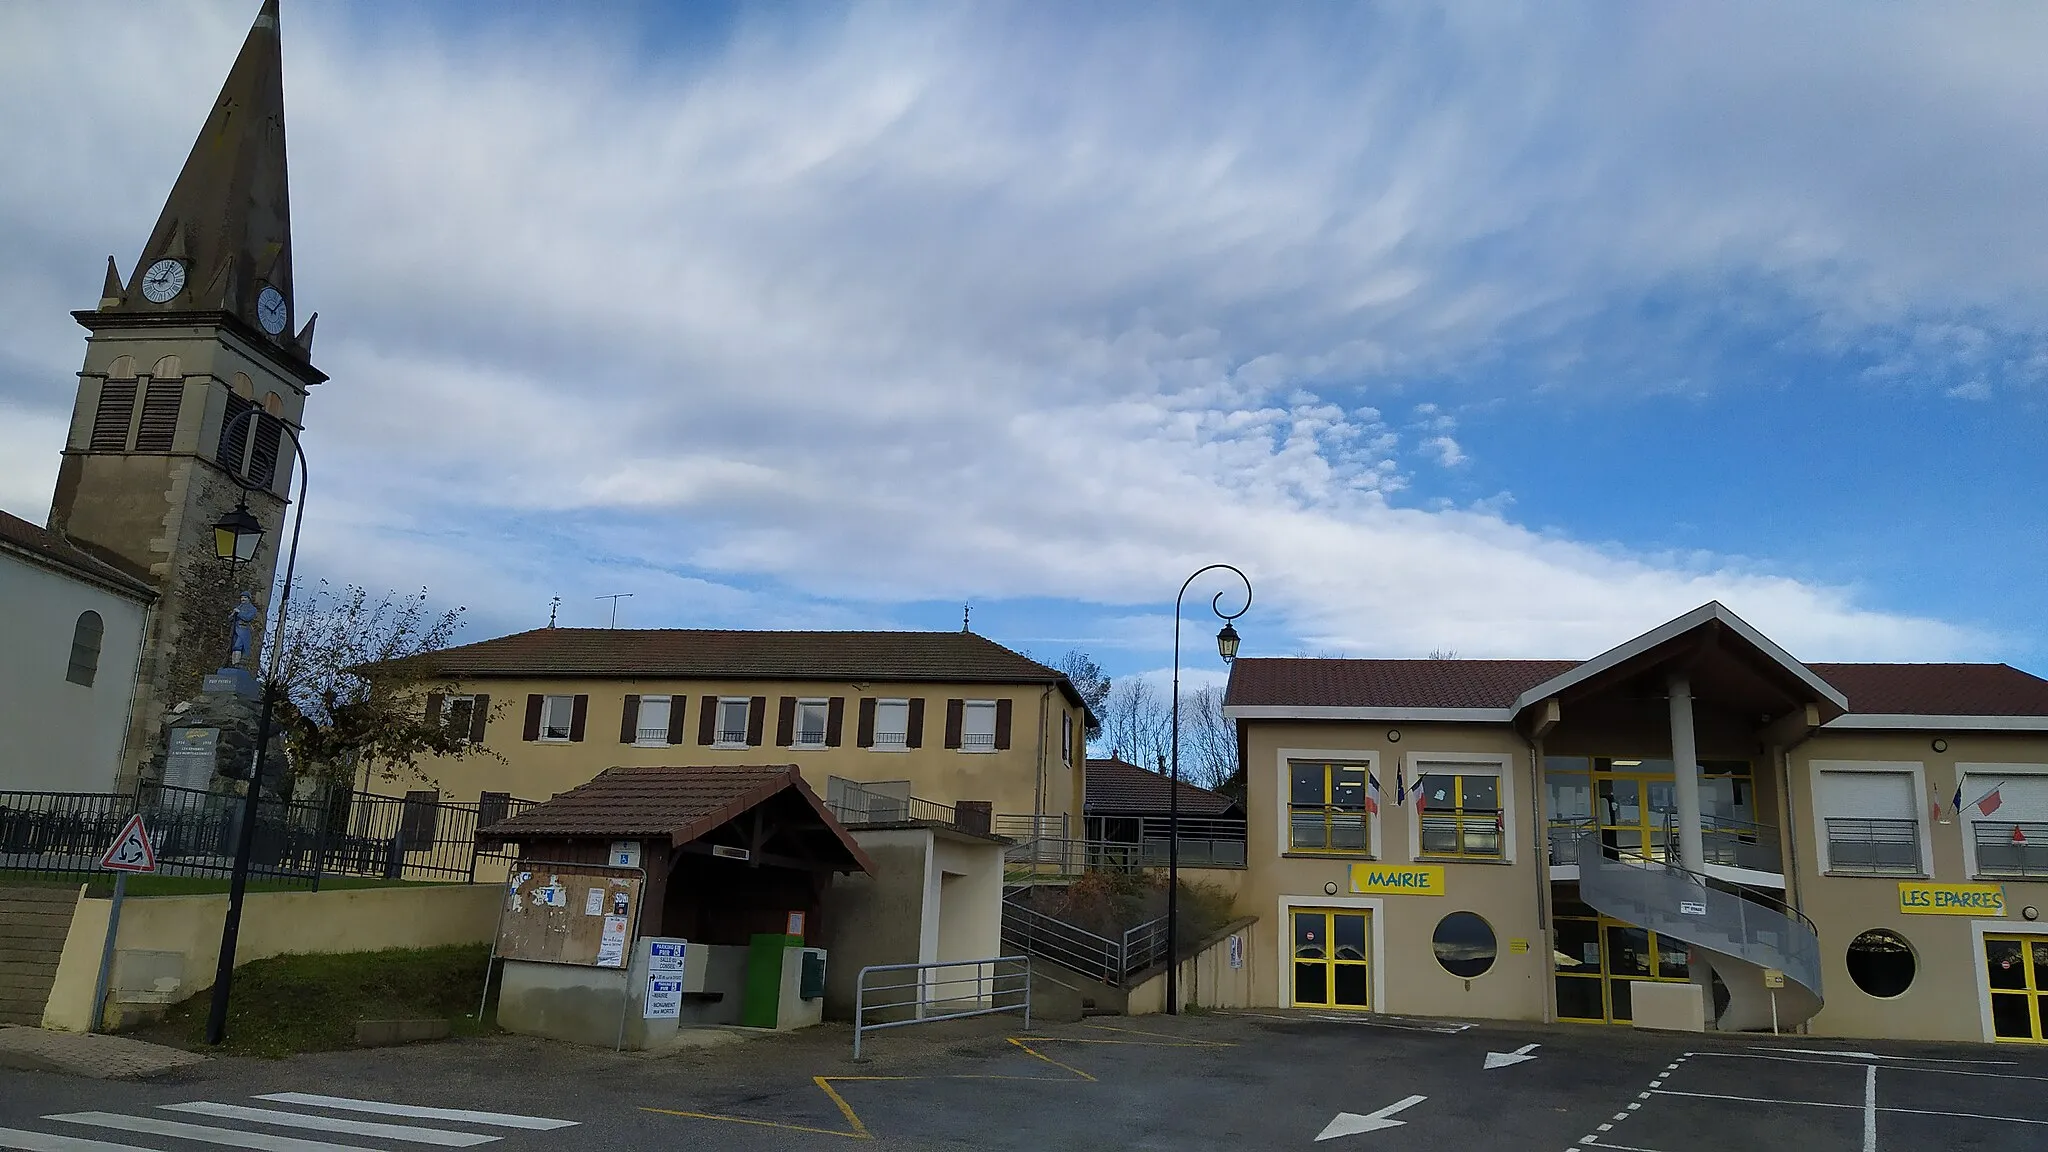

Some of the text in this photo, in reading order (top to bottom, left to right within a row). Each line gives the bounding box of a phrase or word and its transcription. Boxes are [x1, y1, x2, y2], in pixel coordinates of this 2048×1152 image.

[1367, 871, 1431, 888] MAIRIE
[1902, 889, 2004, 909] LES EPARRES
[659, 962, 677, 970] CONSEIL
